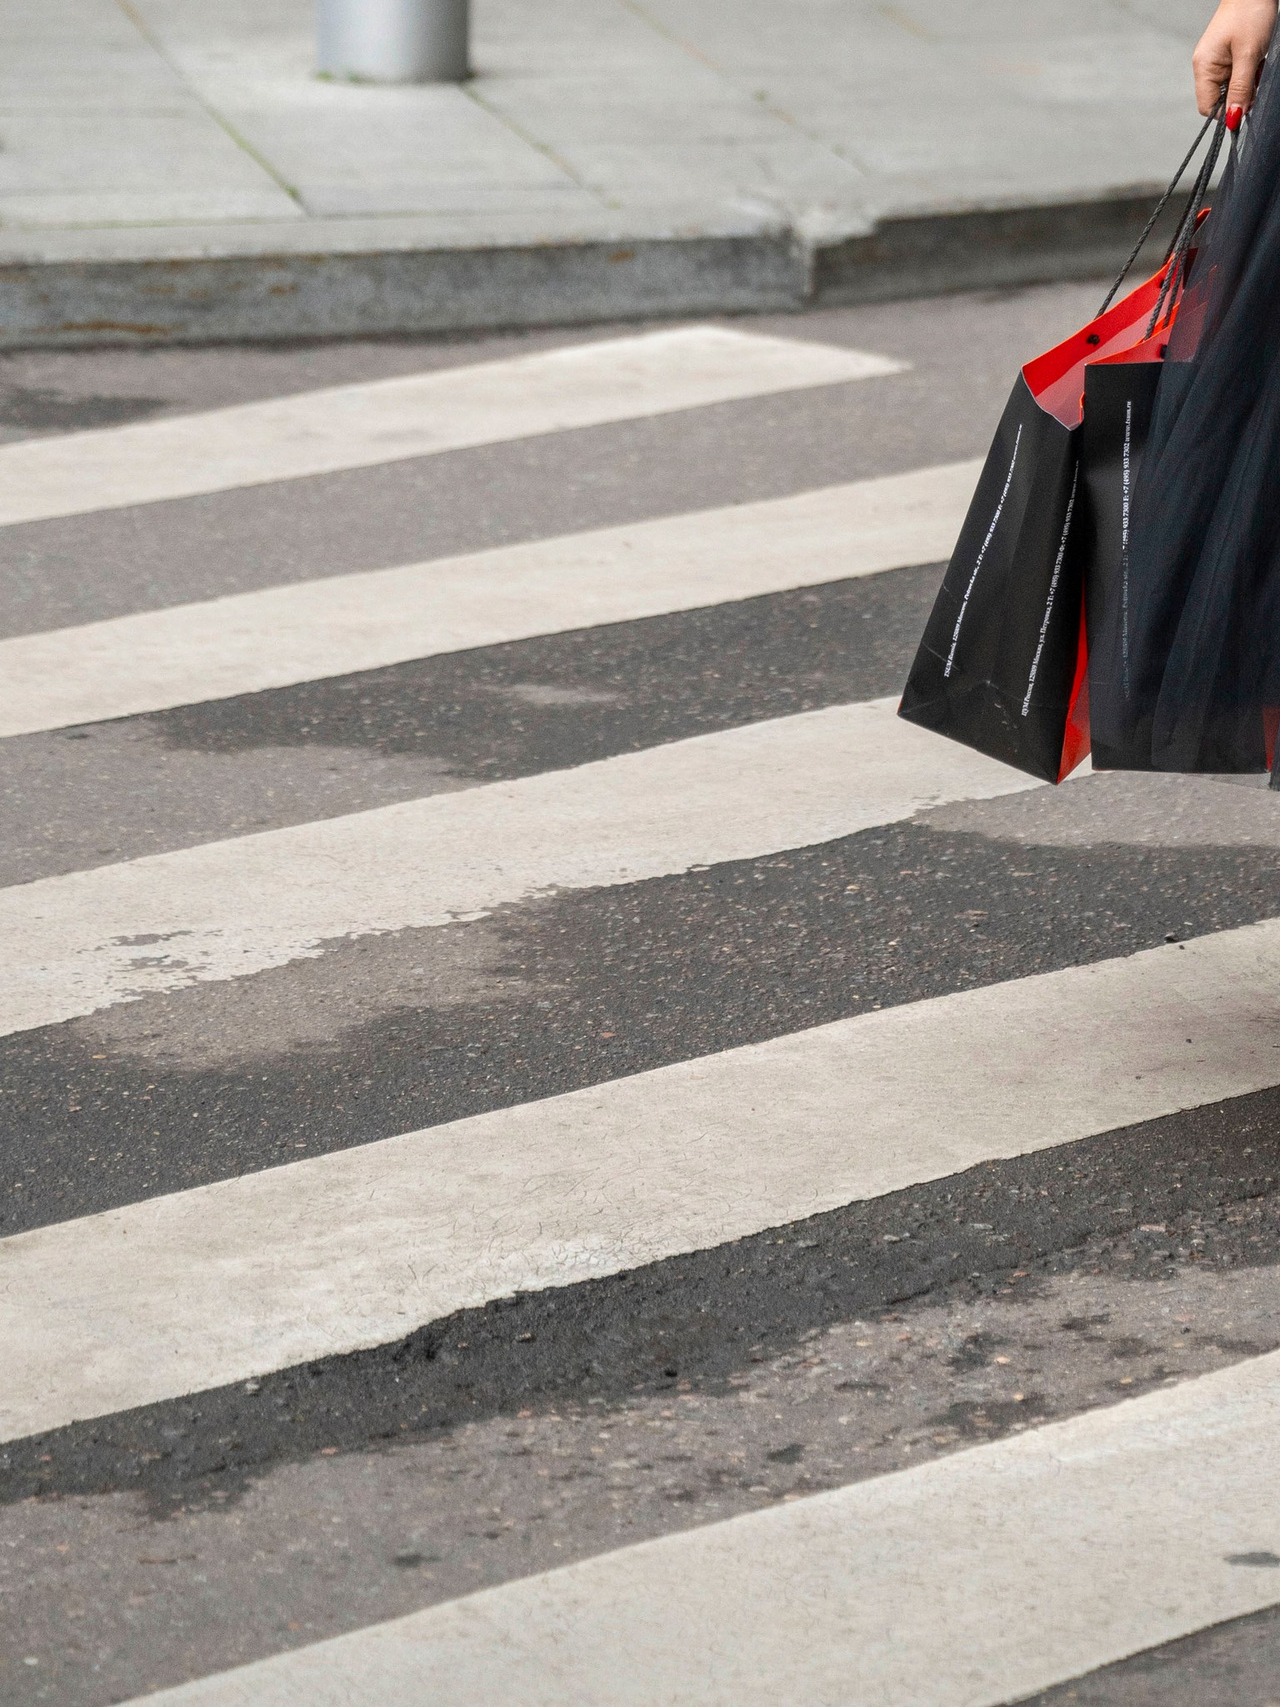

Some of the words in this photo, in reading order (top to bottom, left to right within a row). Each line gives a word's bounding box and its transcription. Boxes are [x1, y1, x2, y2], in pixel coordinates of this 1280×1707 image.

[1122, 469, 1130, 485] (495)
[1032, 643, 1044, 665] Москва,
[1028, 664, 1037, 682] 125009
[1023, 682, 1034, 702] Россия,
